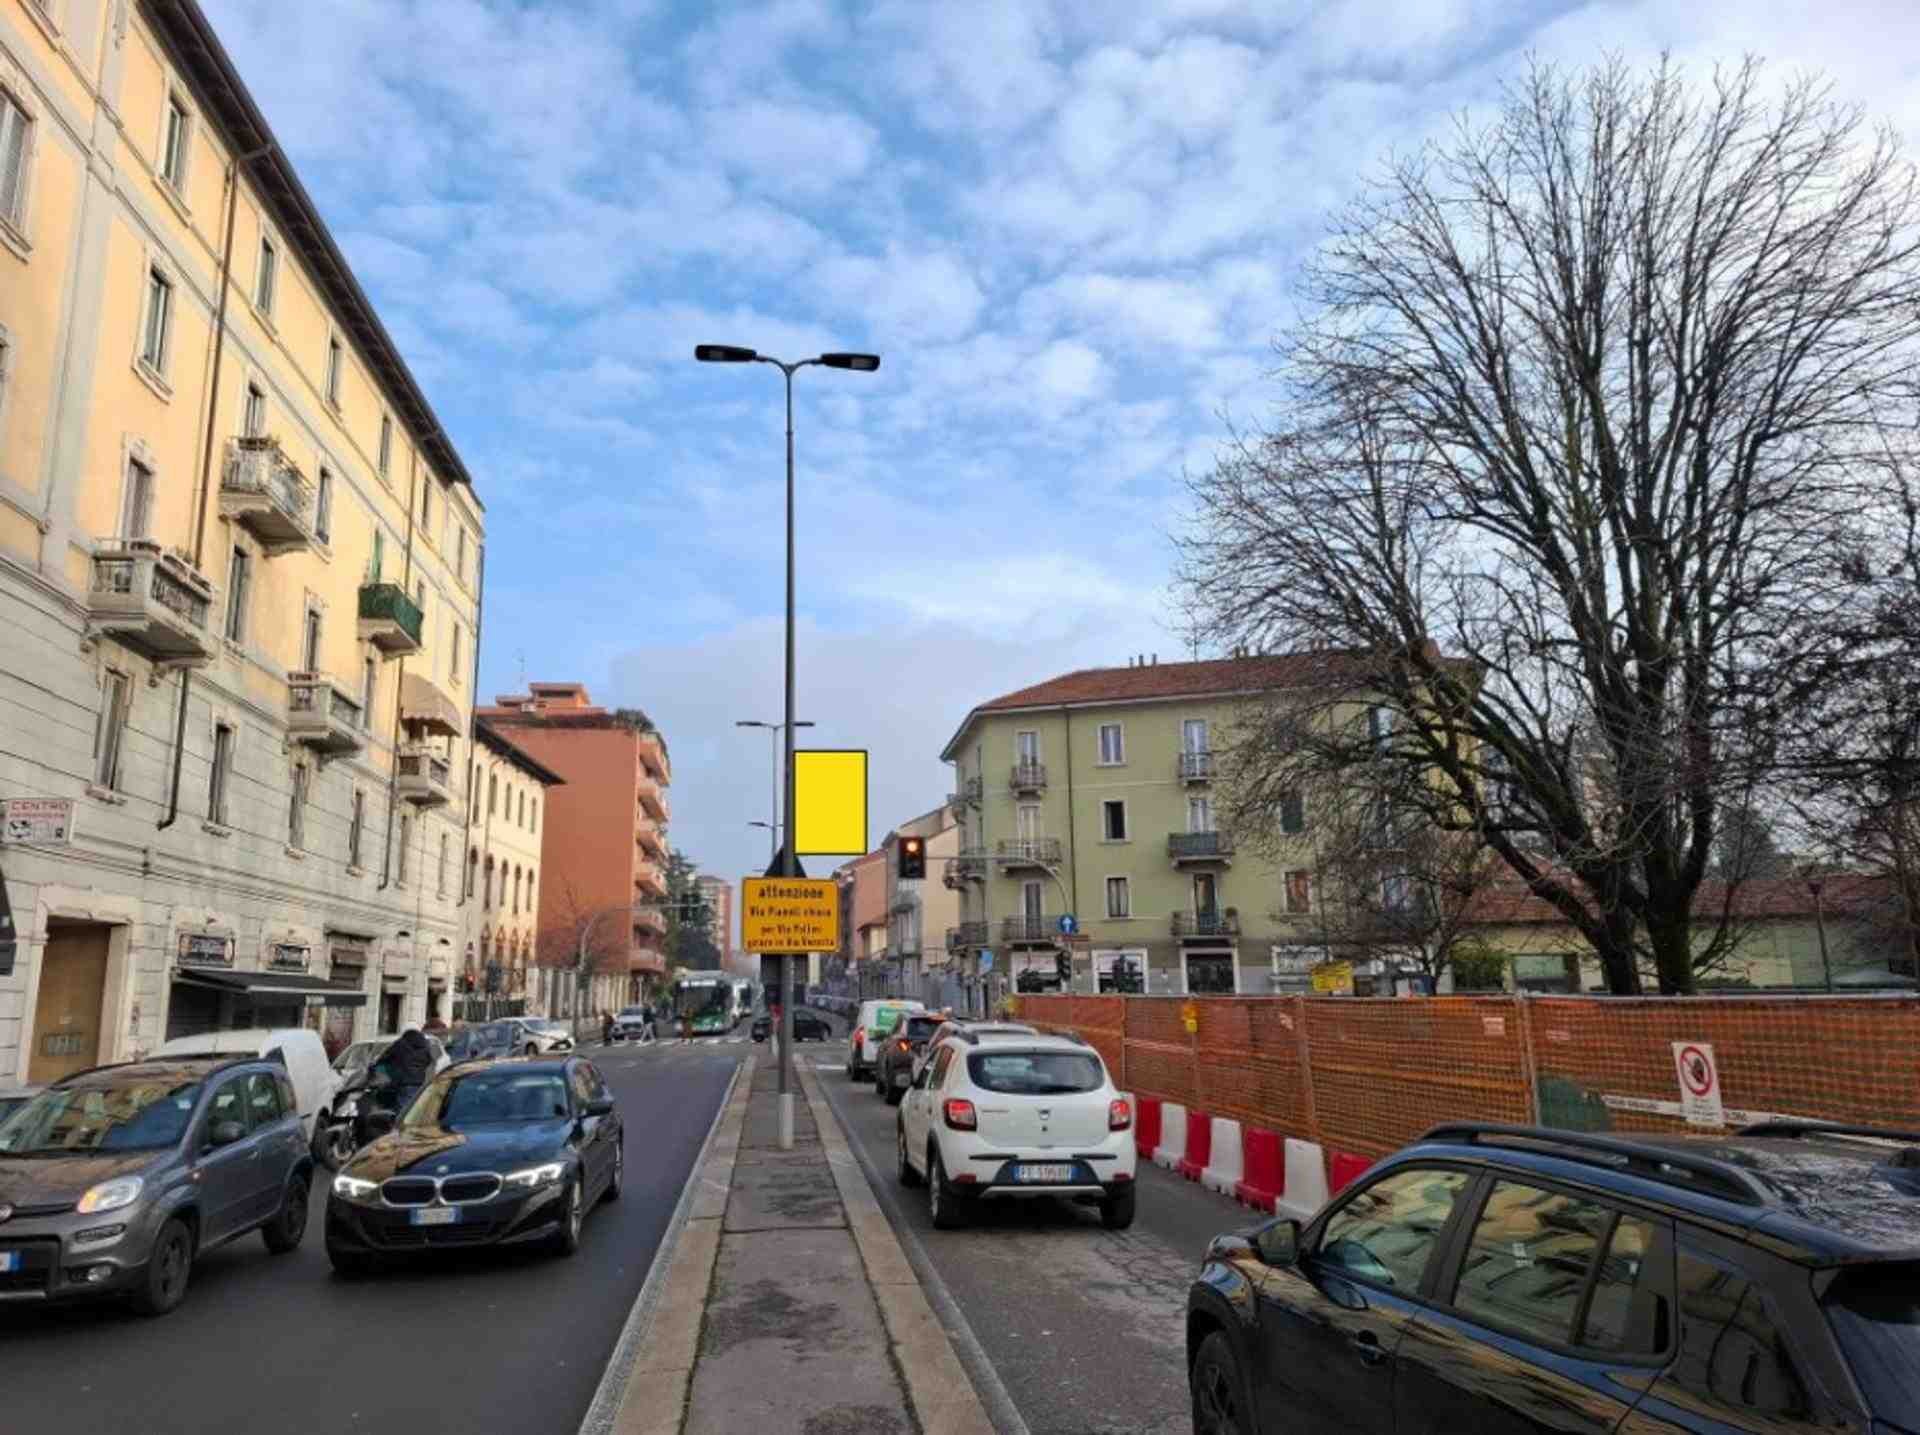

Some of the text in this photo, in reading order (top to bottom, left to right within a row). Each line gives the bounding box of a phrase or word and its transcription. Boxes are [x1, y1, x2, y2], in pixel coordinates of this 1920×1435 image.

[11, 800, 70, 811] CENTRO
[750, 905, 765, 917] Via
[777, 923, 792, 935] Via
